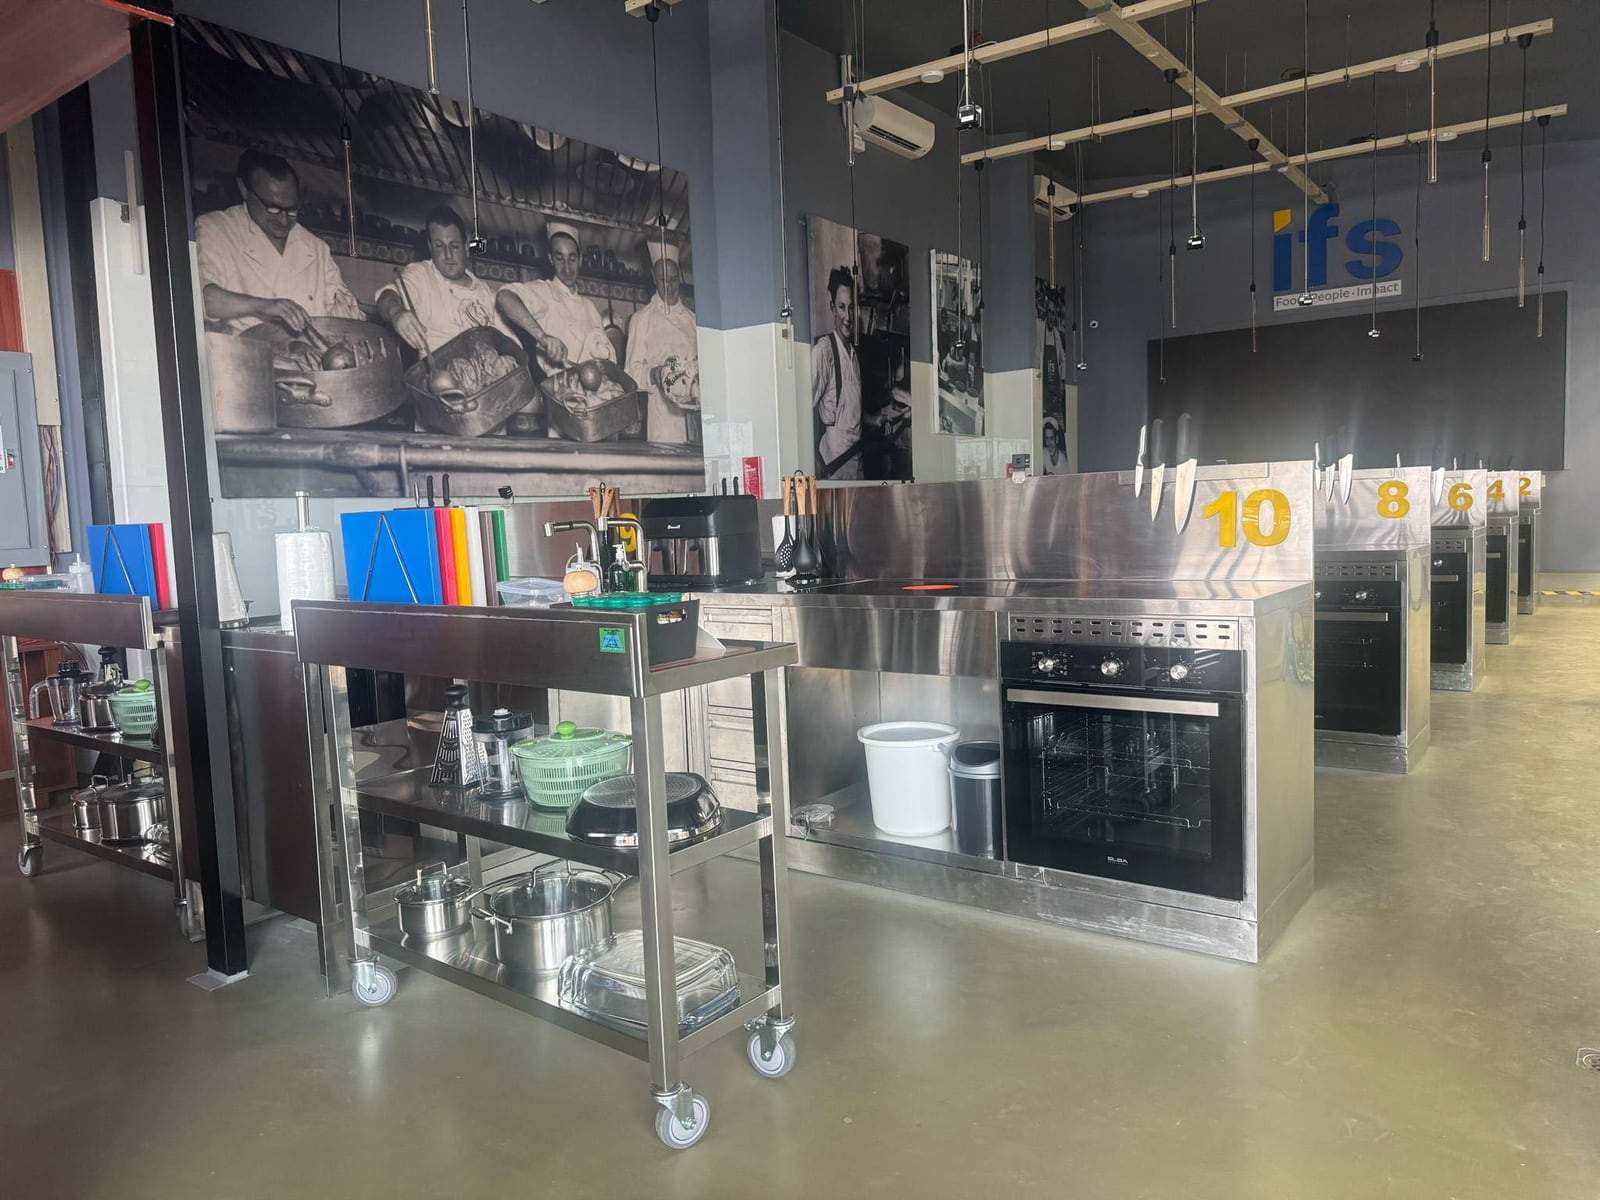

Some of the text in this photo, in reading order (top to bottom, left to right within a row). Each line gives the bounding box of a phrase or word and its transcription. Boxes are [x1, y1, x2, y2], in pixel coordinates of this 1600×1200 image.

[1273, 203, 1403, 292] ifs
[1276, 283, 1399, 308] Foo People Impact
[1376, 480, 1410, 519] 8
[1447, 482, 1474, 511] 6
[1487, 479, 1505, 502] 4
[1519, 477, 1532, 496] 2
[1202, 489, 1291, 548] 10
